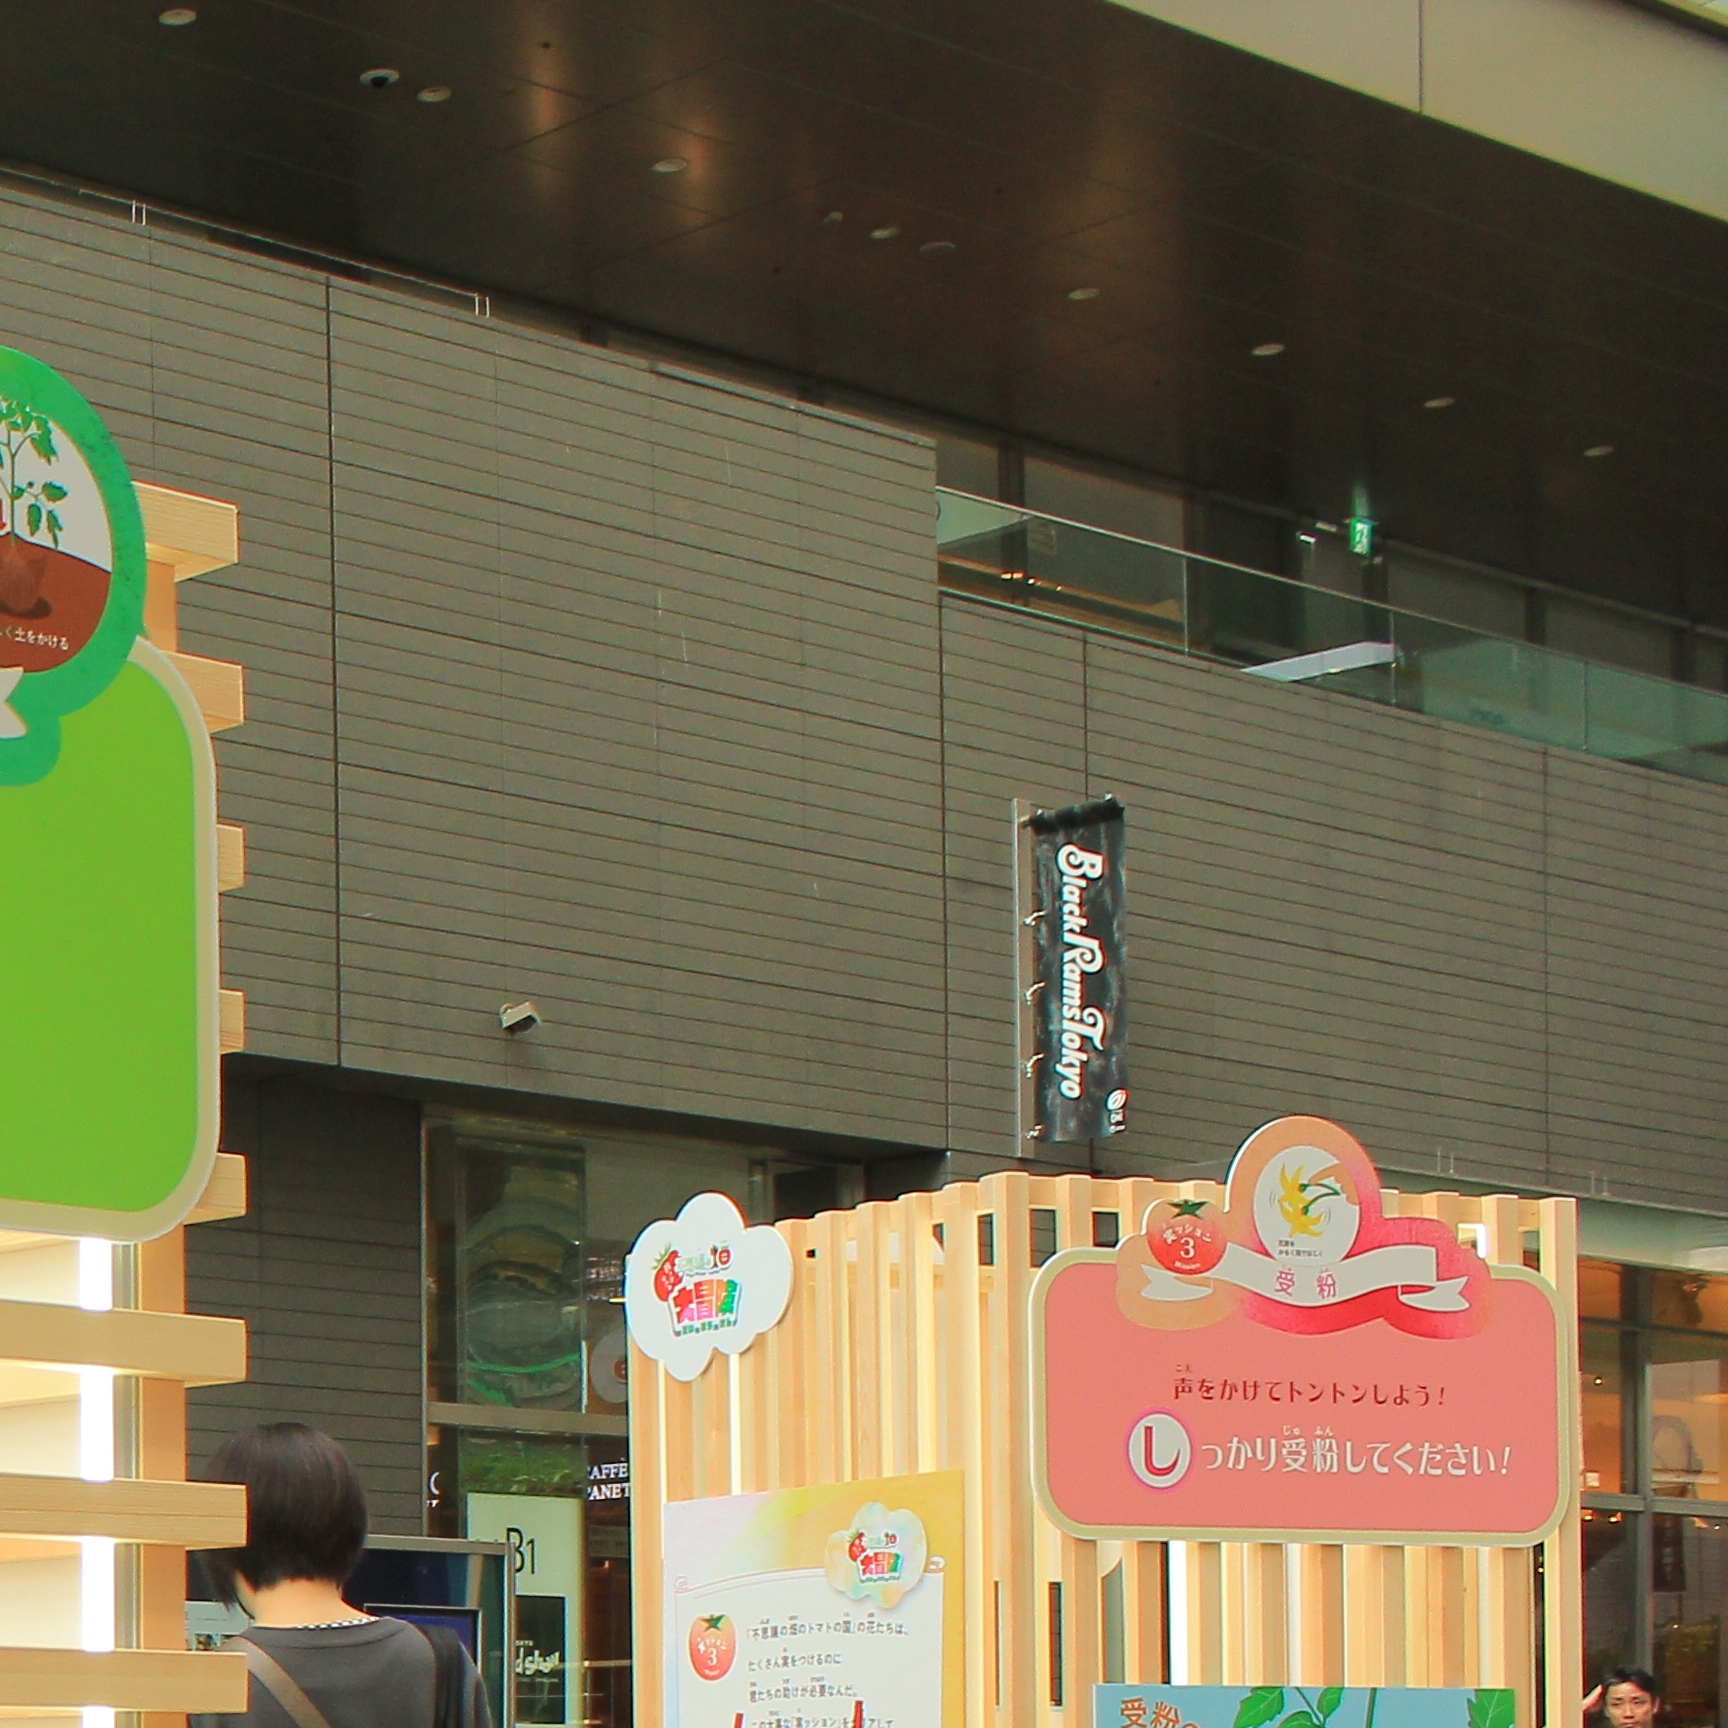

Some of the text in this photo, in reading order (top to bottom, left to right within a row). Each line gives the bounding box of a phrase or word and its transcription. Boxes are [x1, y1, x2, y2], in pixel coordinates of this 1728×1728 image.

[1054, 843, 1107, 1100] Black Rams Tokyo
[1179, 1237, 1196, 1259] 3
[1274, 1269, 1338, 1299] 受粉
[1173, 1377, 1447, 1407] 声をかけてトントンしよう！
[1201, 1437, 1512, 1477] っかり受粉してください！
[707, 1648, 718, 1667] 3
